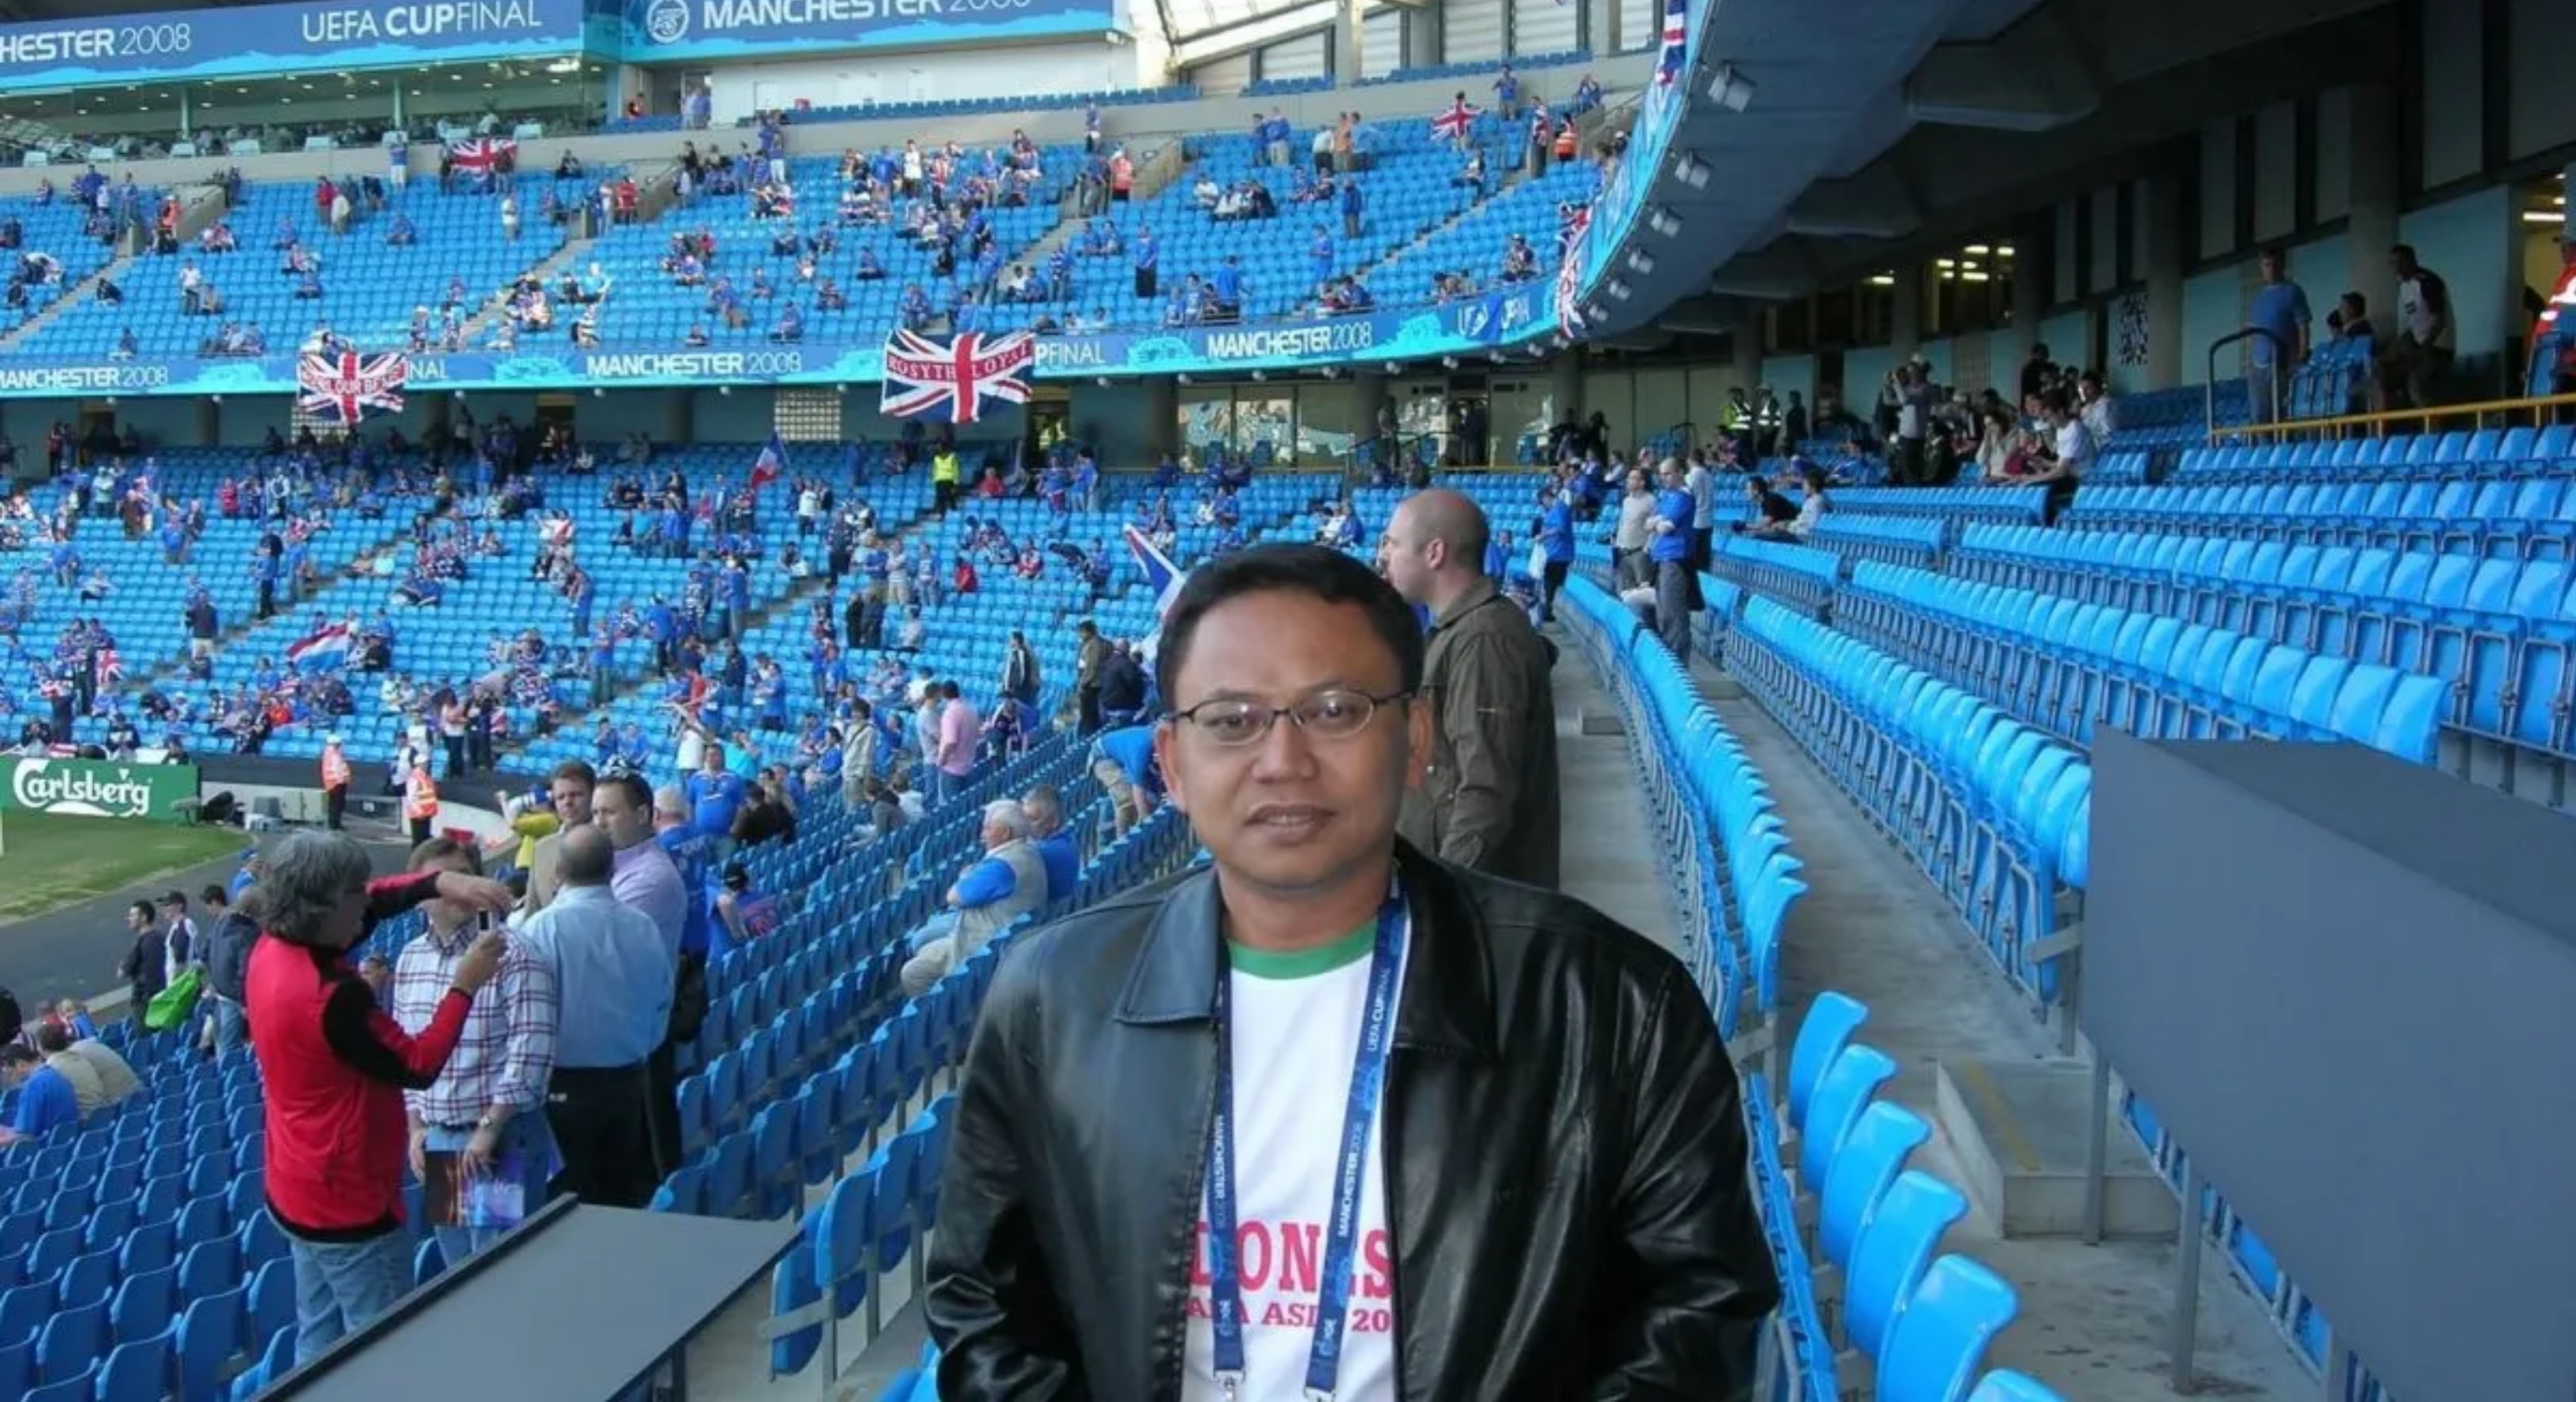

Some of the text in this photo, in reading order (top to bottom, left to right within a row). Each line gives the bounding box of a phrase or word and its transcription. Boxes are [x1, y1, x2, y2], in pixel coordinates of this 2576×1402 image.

[0, 23, 191, 63] HESTER 2008
[302, 10, 379, 42] UEFA
[1208, 321, 1372, 358] MANCHESTER 2008
[122, 365, 168, 386] 2008
[587, 352, 802, 377] MANCHESTER 2008
[13, 758, 151, 817] Carlsberg
[1190, 1220, 1392, 1299] ONS
